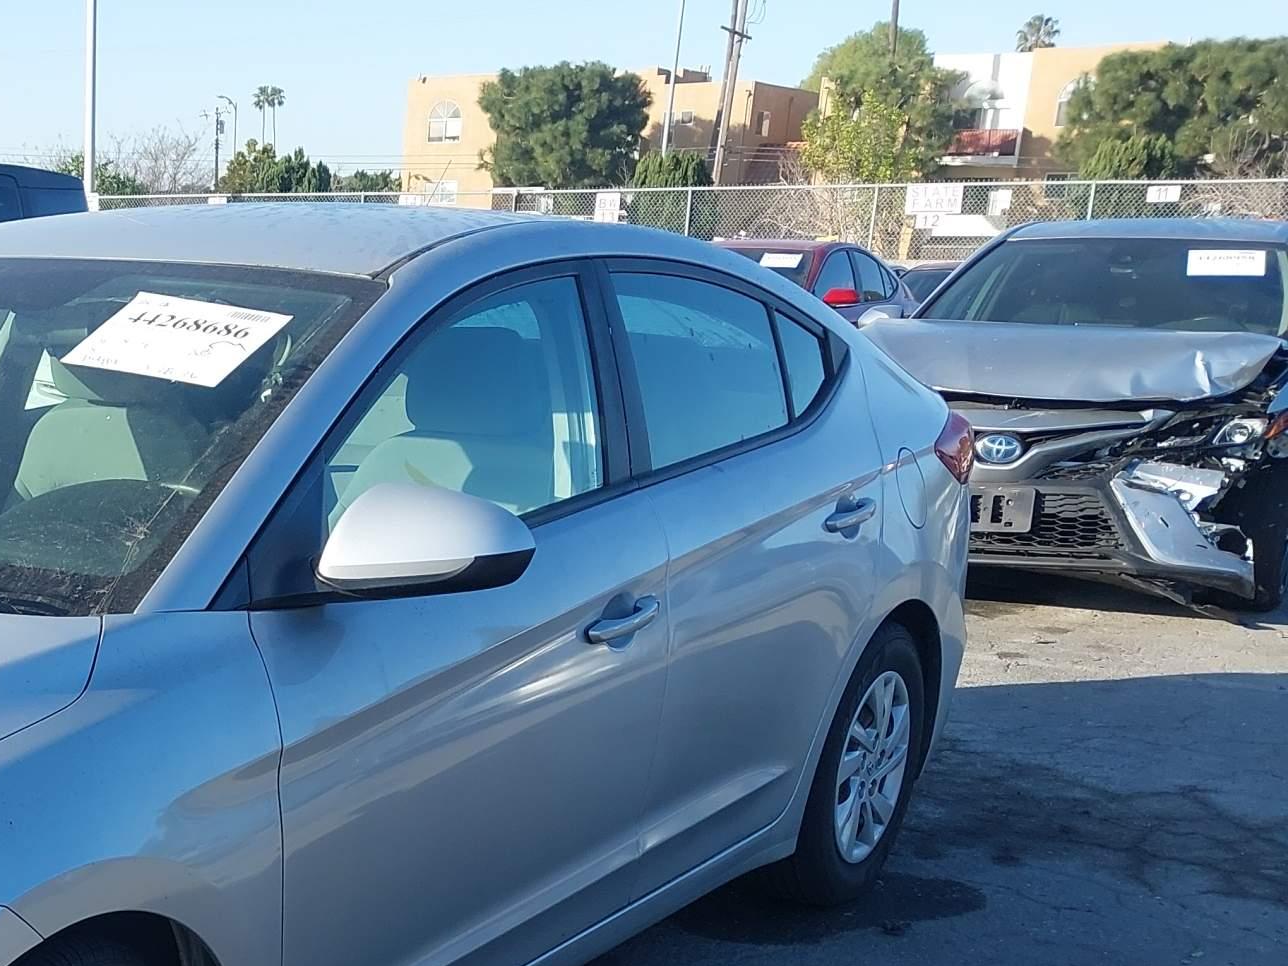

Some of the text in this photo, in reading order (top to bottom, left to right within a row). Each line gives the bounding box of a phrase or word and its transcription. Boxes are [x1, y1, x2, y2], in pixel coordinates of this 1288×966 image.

[911, 186, 960, 198] STATE
[1156, 188, 1169, 201] 11
[911, 198, 959, 209] FARM
[923, 215, 940, 227] 12
[126, 311, 251, 340] 44268686
